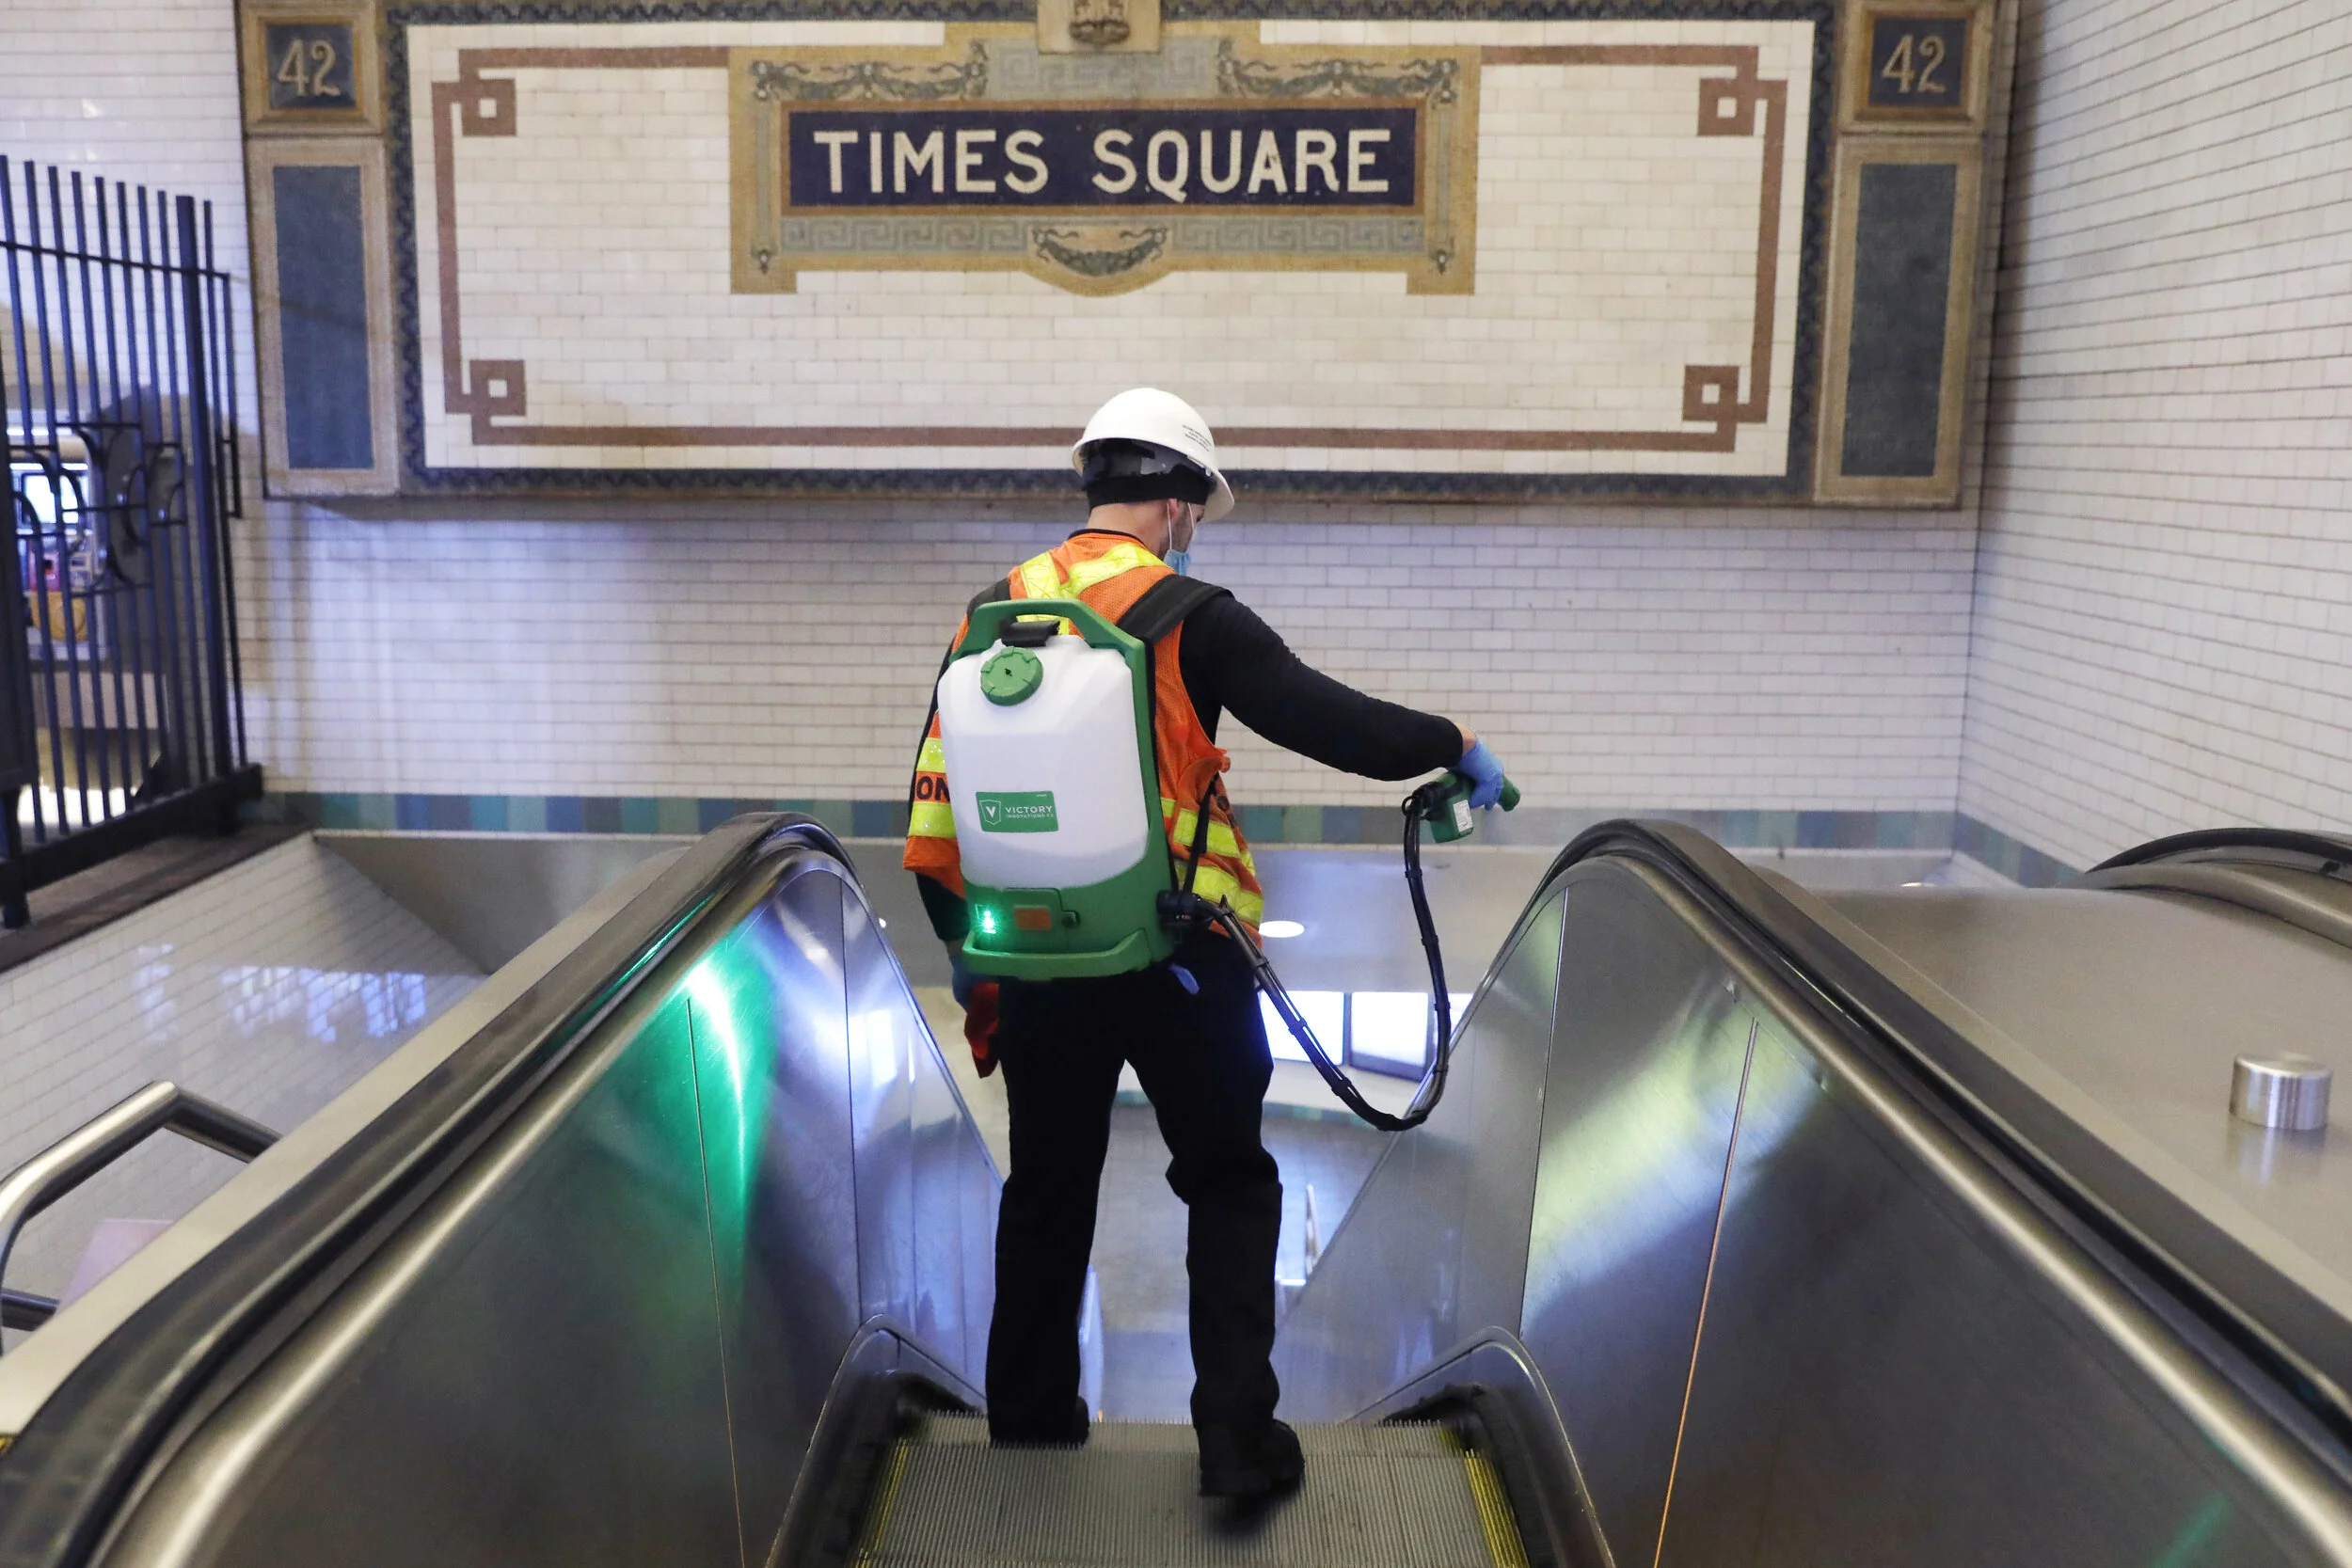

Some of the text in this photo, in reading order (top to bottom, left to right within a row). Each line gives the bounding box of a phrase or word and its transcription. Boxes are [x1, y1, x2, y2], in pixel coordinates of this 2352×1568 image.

[277, 39, 341, 96] 42
[1882, 33, 1947, 93] 42
[813, 128, 1391, 203] TIMES SQUARE
[1005, 805, 1053, 814] VICTORY
